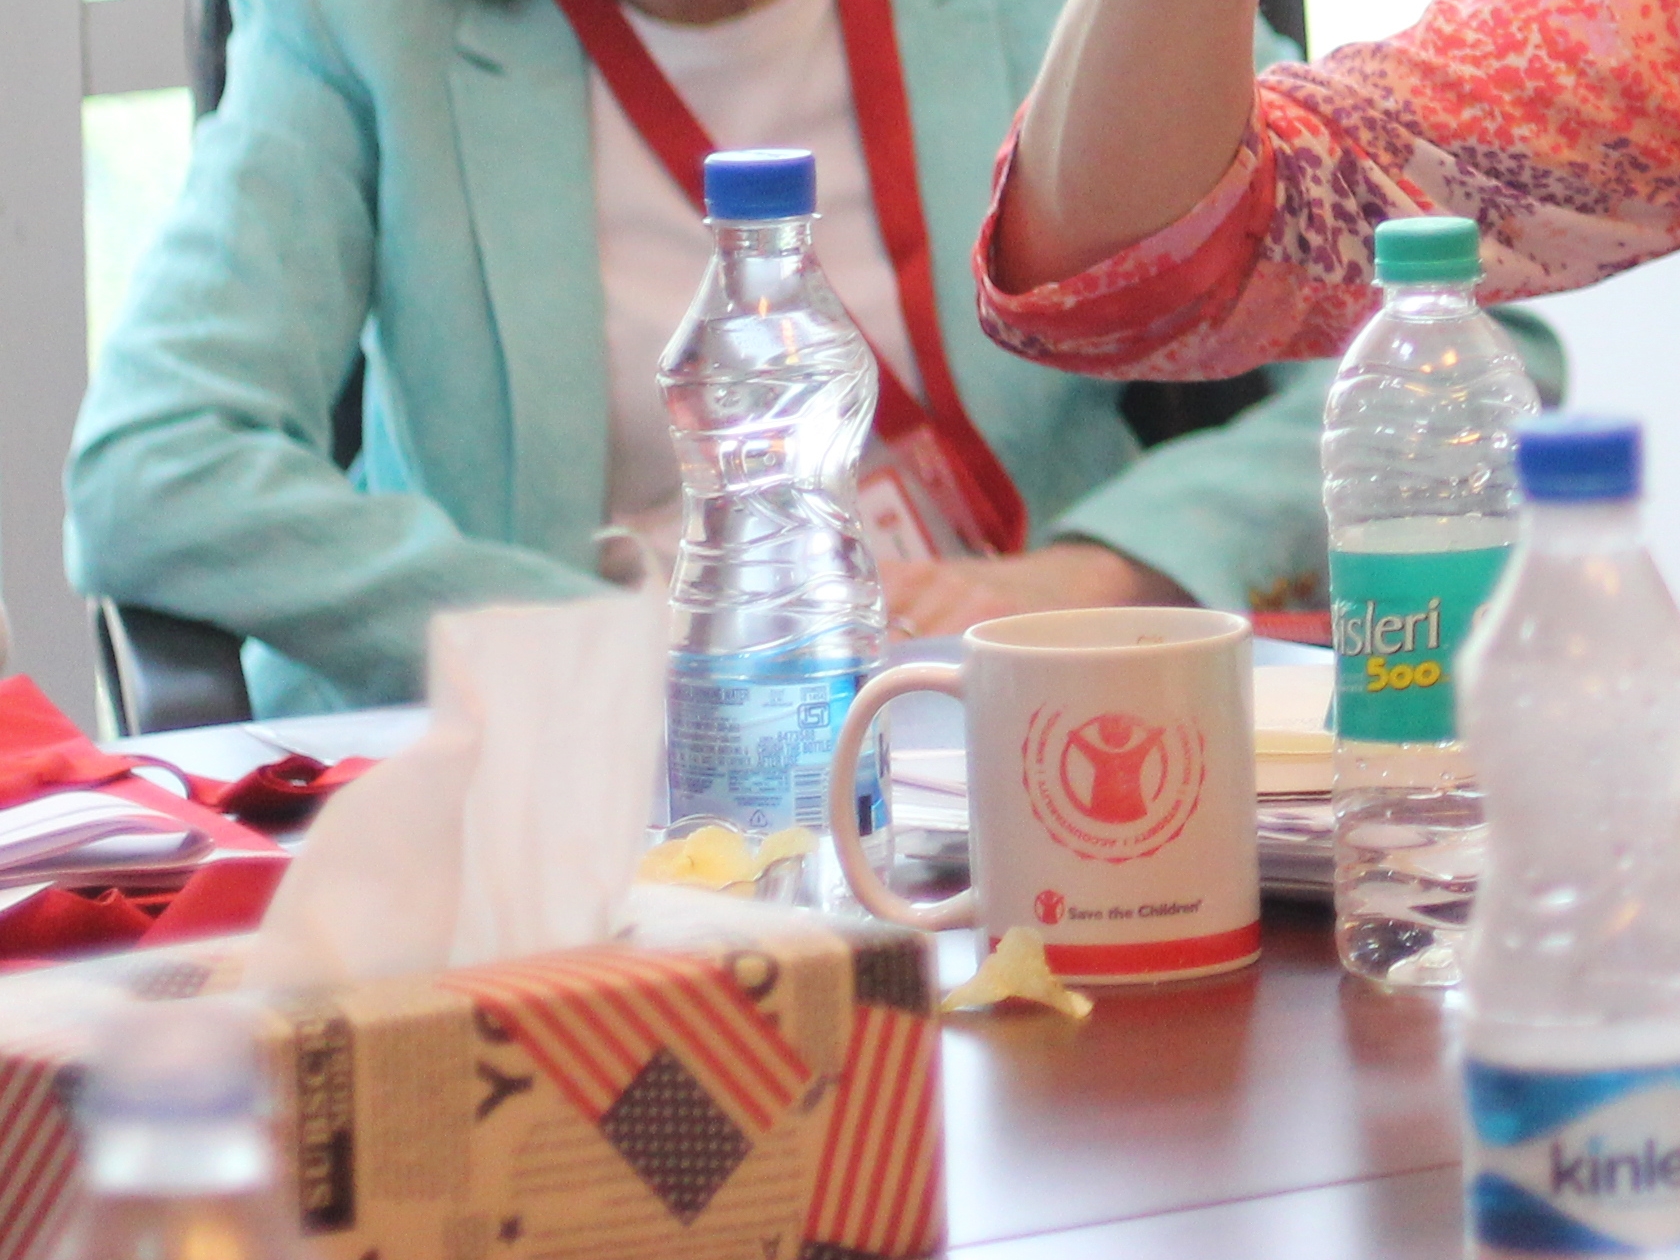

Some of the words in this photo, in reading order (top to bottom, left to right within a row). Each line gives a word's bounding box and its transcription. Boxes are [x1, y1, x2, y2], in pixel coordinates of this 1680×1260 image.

[1366, 657, 1441, 693] 500
[1068, 906, 1103, 921] Save
[1108, 906, 1134, 920] the
[1137, 902, 1199, 919] Children
